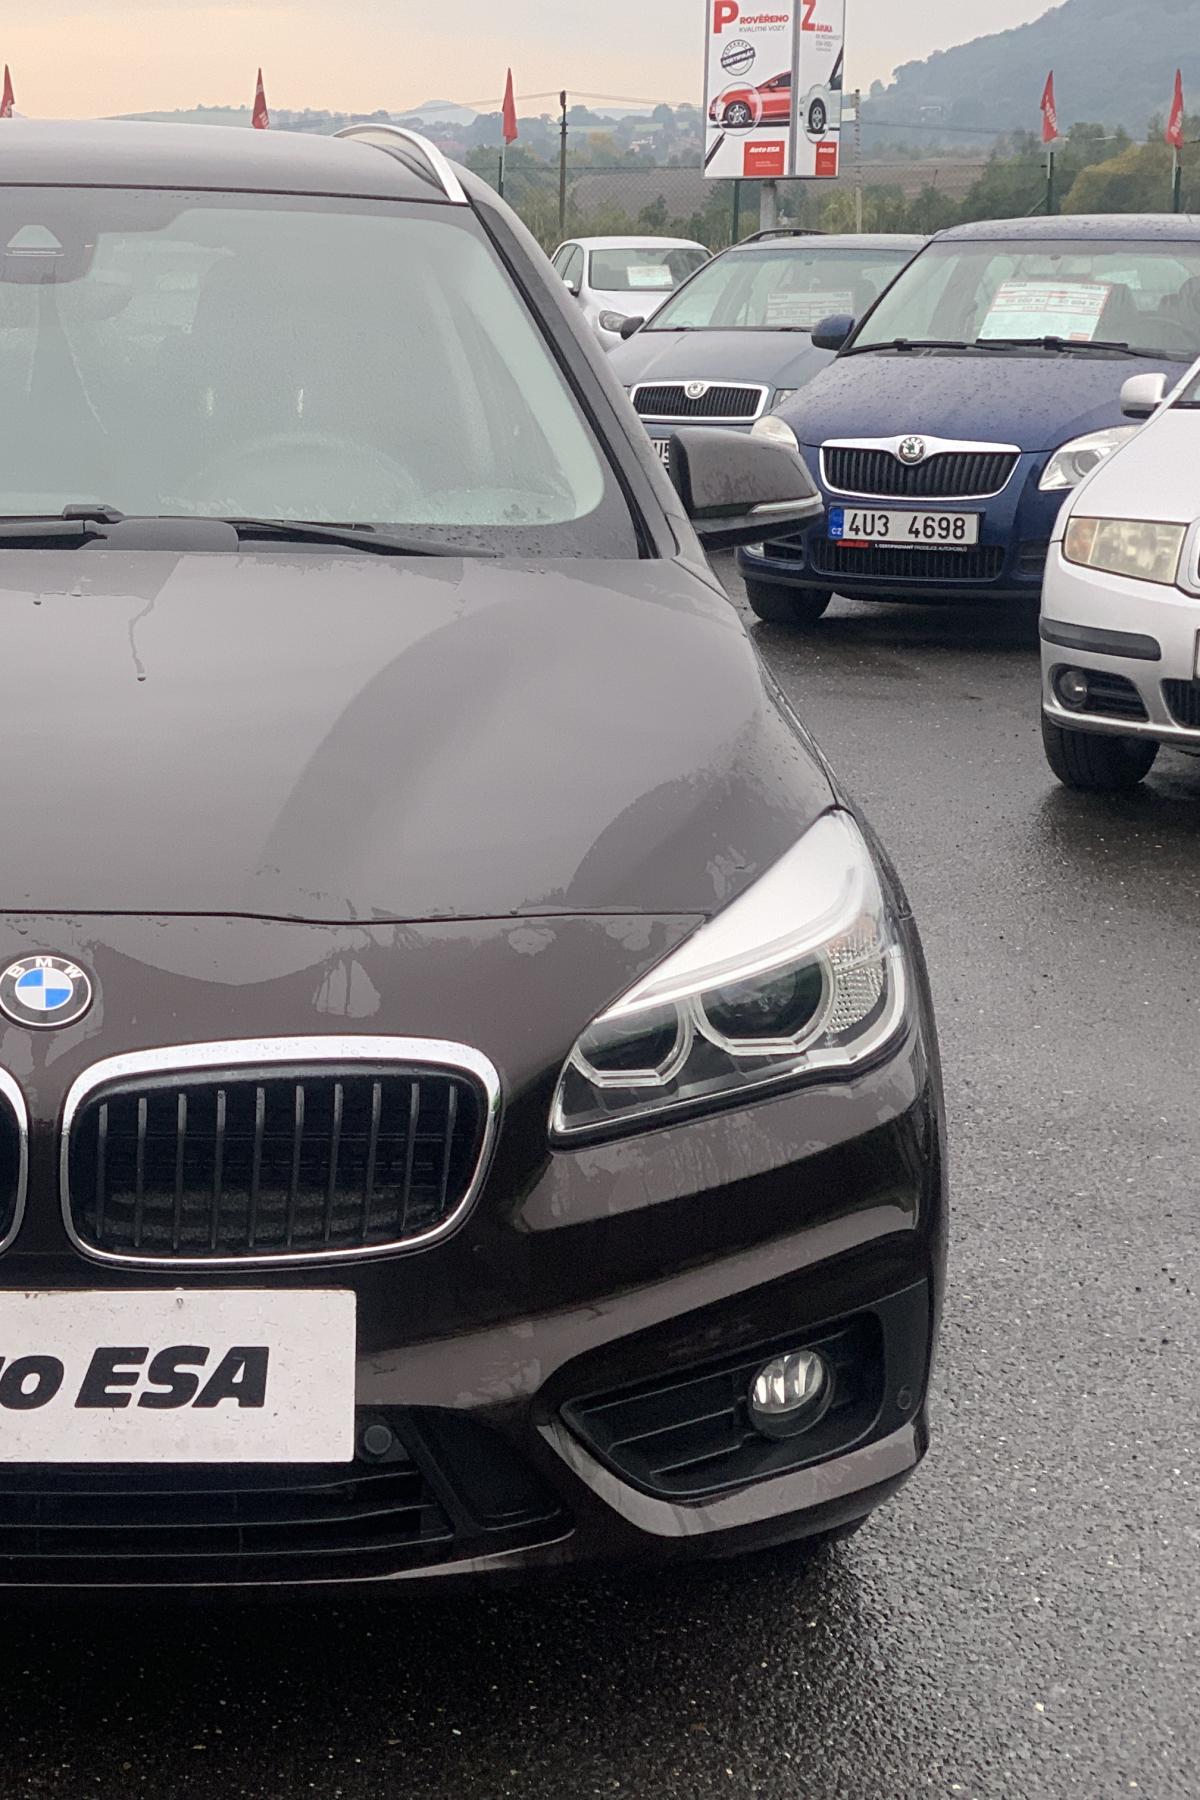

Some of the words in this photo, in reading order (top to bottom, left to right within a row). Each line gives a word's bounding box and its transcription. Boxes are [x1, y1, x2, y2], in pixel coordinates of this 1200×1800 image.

[831, 527, 842, 536] CZ
[849, 513, 890, 537] 4U3
[908, 515, 965, 540] 4698
[7, 957, 83, 979] BMW
[74, 1345, 269, 1409] ESA
